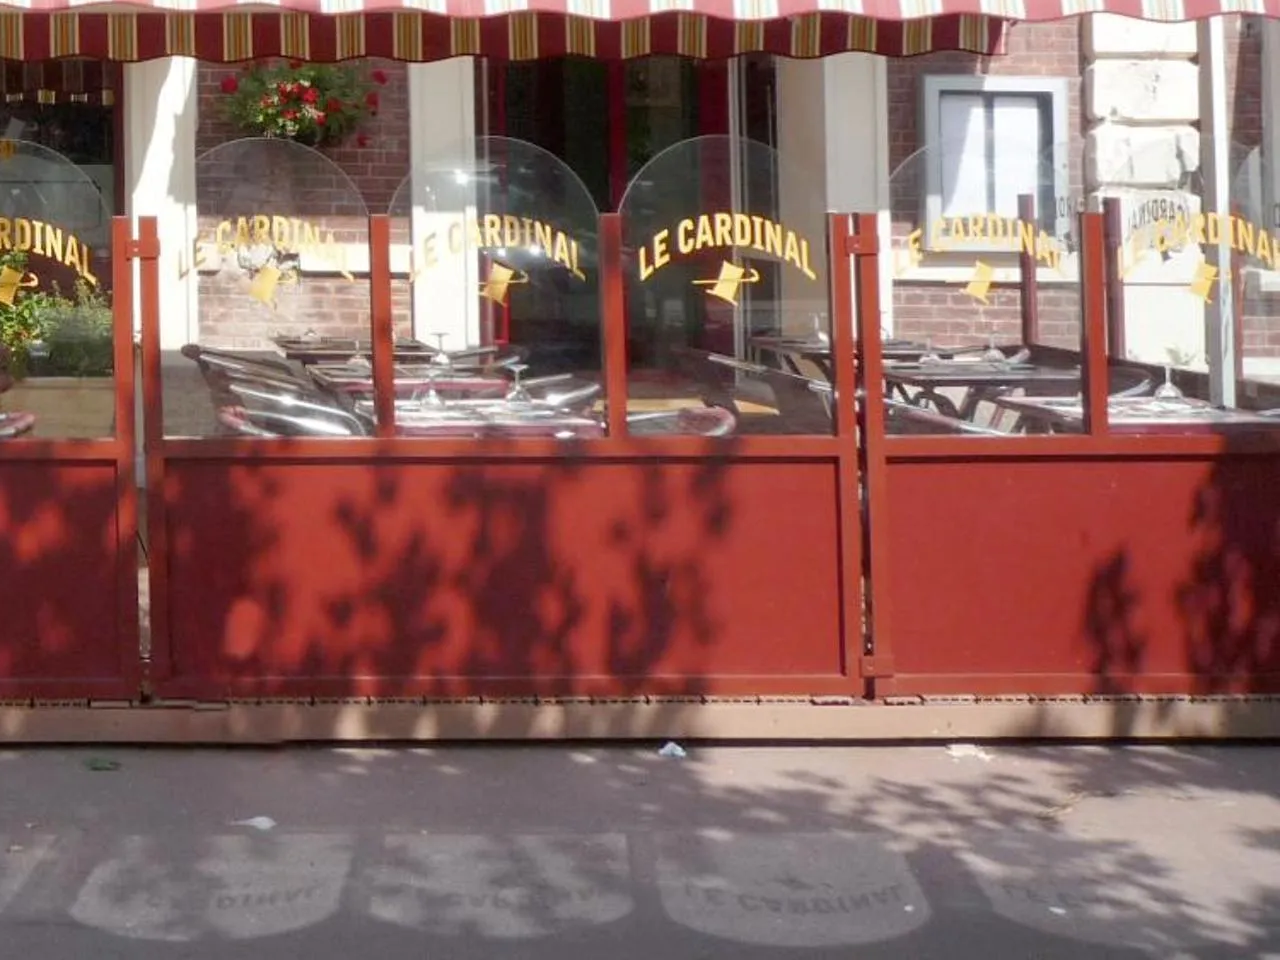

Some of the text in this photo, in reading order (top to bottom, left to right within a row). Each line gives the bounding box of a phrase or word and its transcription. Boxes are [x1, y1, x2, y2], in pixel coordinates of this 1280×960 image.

[176, 234, 207, 282] LE
[448, 213, 586, 282] CARDINAL
[639, 213, 816, 282] LE CARDINAL
